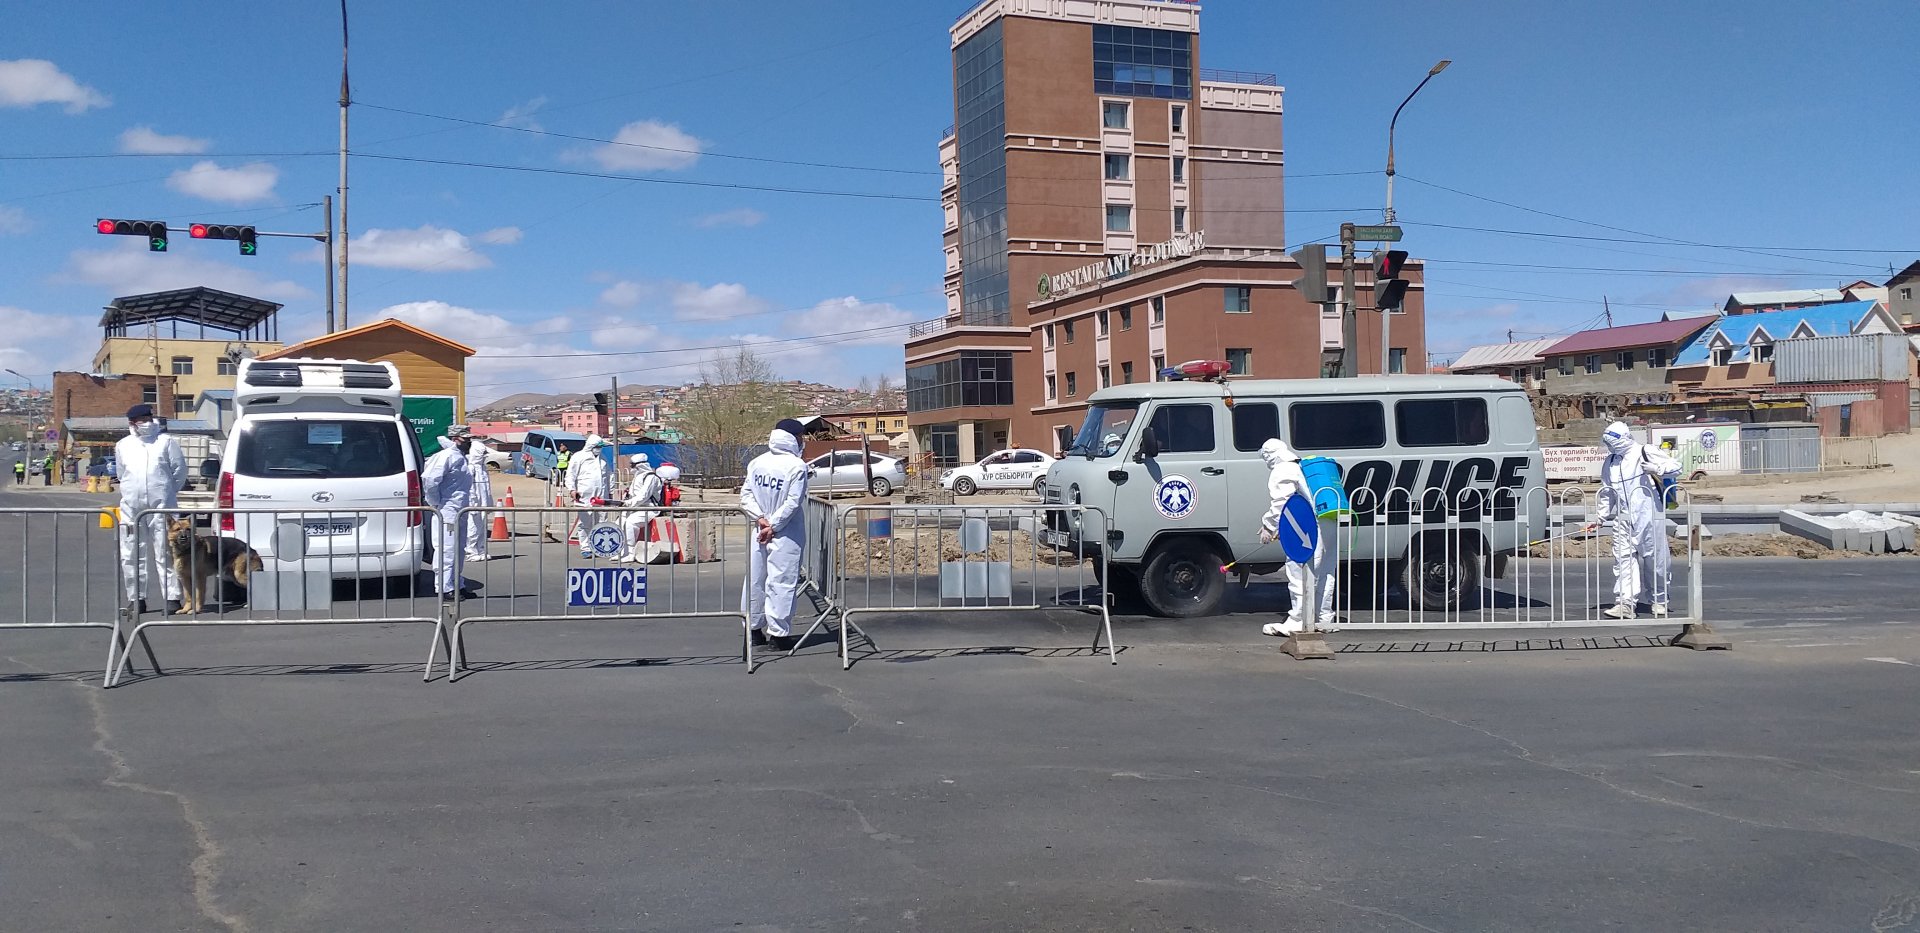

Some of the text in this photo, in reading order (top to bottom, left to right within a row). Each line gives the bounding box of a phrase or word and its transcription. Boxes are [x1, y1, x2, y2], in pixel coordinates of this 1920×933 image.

[1052, 252, 1135, 292] RESTAURANT
[1140, 229, 1206, 267] LOUNGE
[1583, 455, 1607, 463] гарган
[1692, 454, 1720, 464] POLICE
[755, 474, 784, 490] POLICE
[982, 472, 1033, 481] ХУР СЕКЬЮРИТИ
[1334, 456, 1531, 517] OLICE
[1162, 507, 1190, 517] POLICE
[568, 570, 646, 604] POLICE
